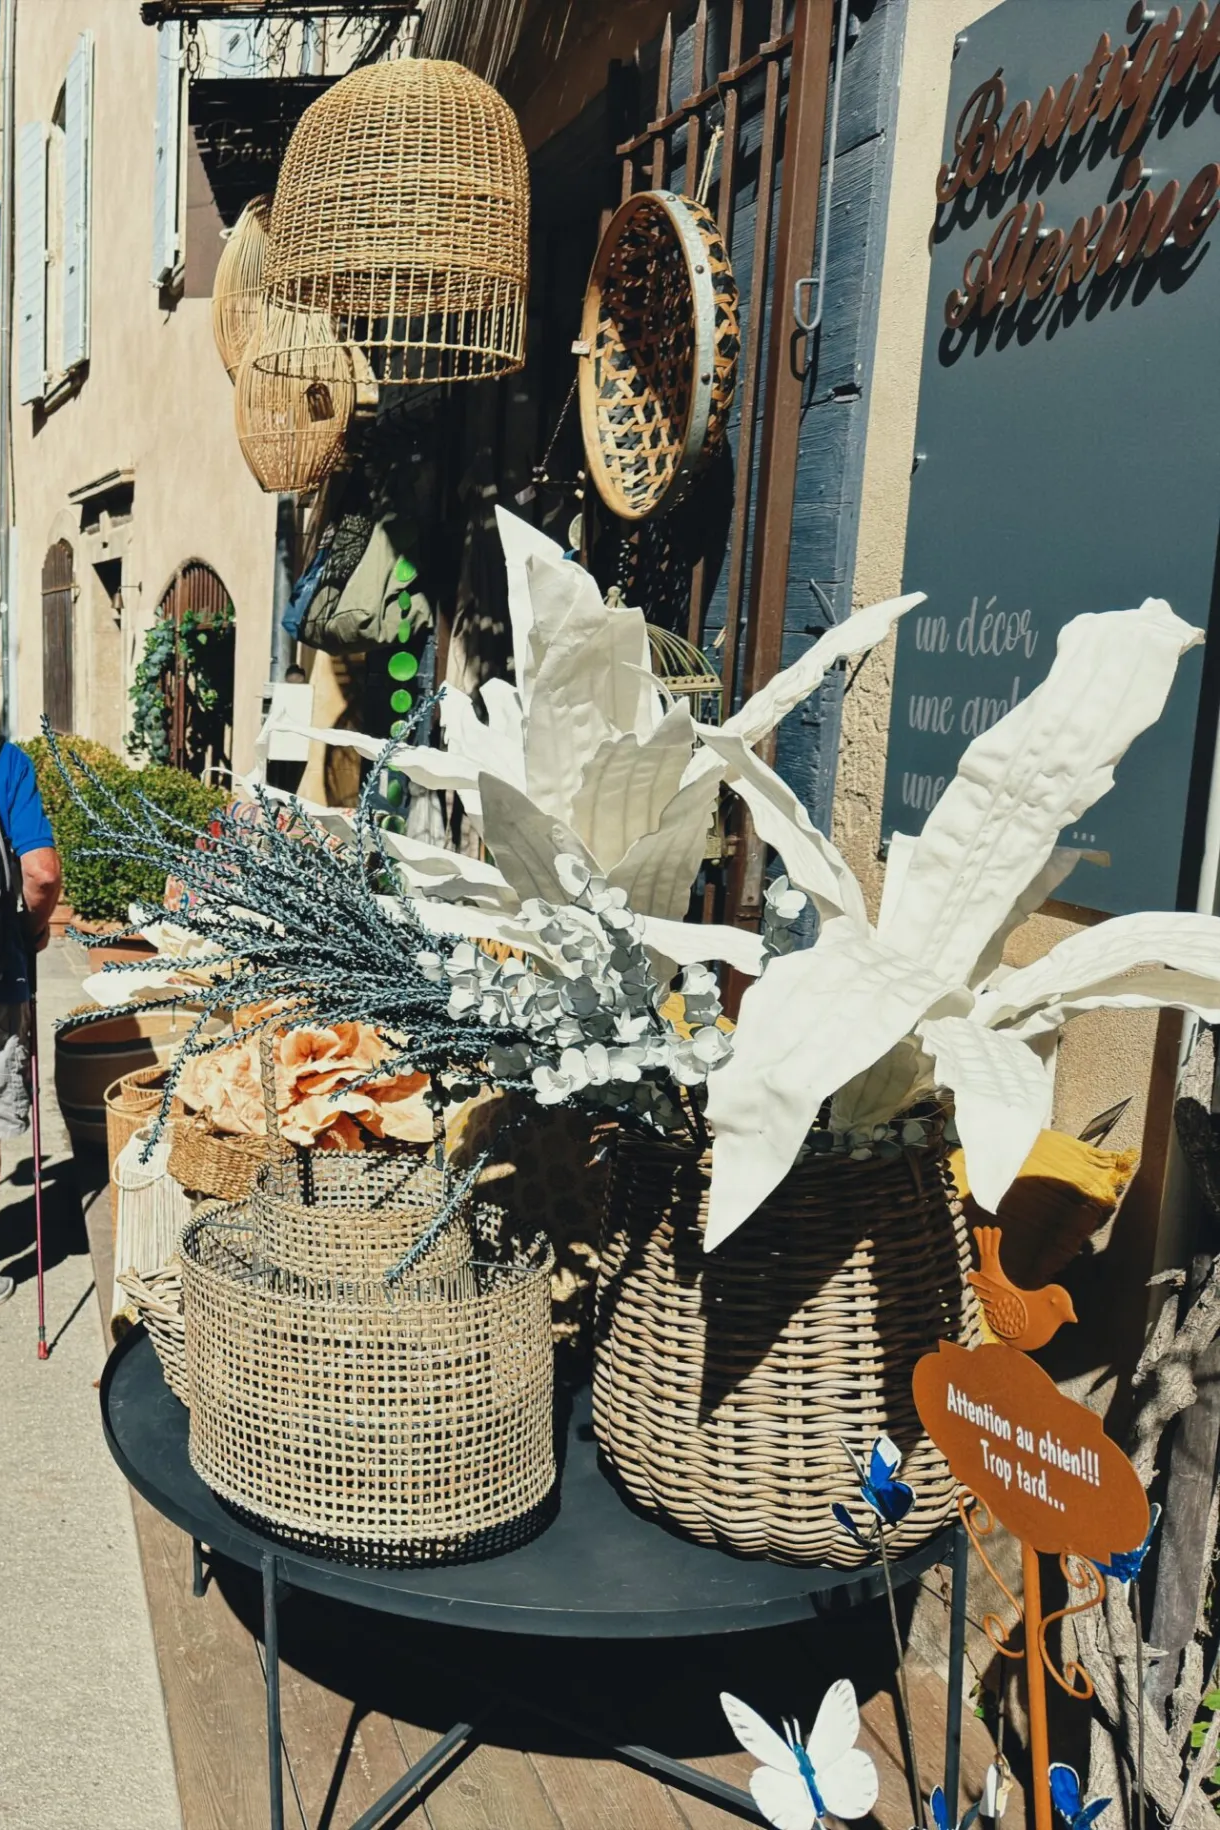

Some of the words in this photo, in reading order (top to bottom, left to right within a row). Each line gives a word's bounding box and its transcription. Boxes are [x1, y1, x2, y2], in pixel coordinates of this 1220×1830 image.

[945, 156, 1220, 329] Alexine
[915, 613, 950, 655] un
[956, 596, 1039, 659] décor
[908, 694, 955, 735] une
[947, 1382, 1012, 1441] Attention
[1016, 1426, 1035, 1454] au
[1038, 1431, 1101, 1488] chien!!!
[980, 1438, 1012, 1491] Trop
[1016, 1462, 1066, 1513] tard...
